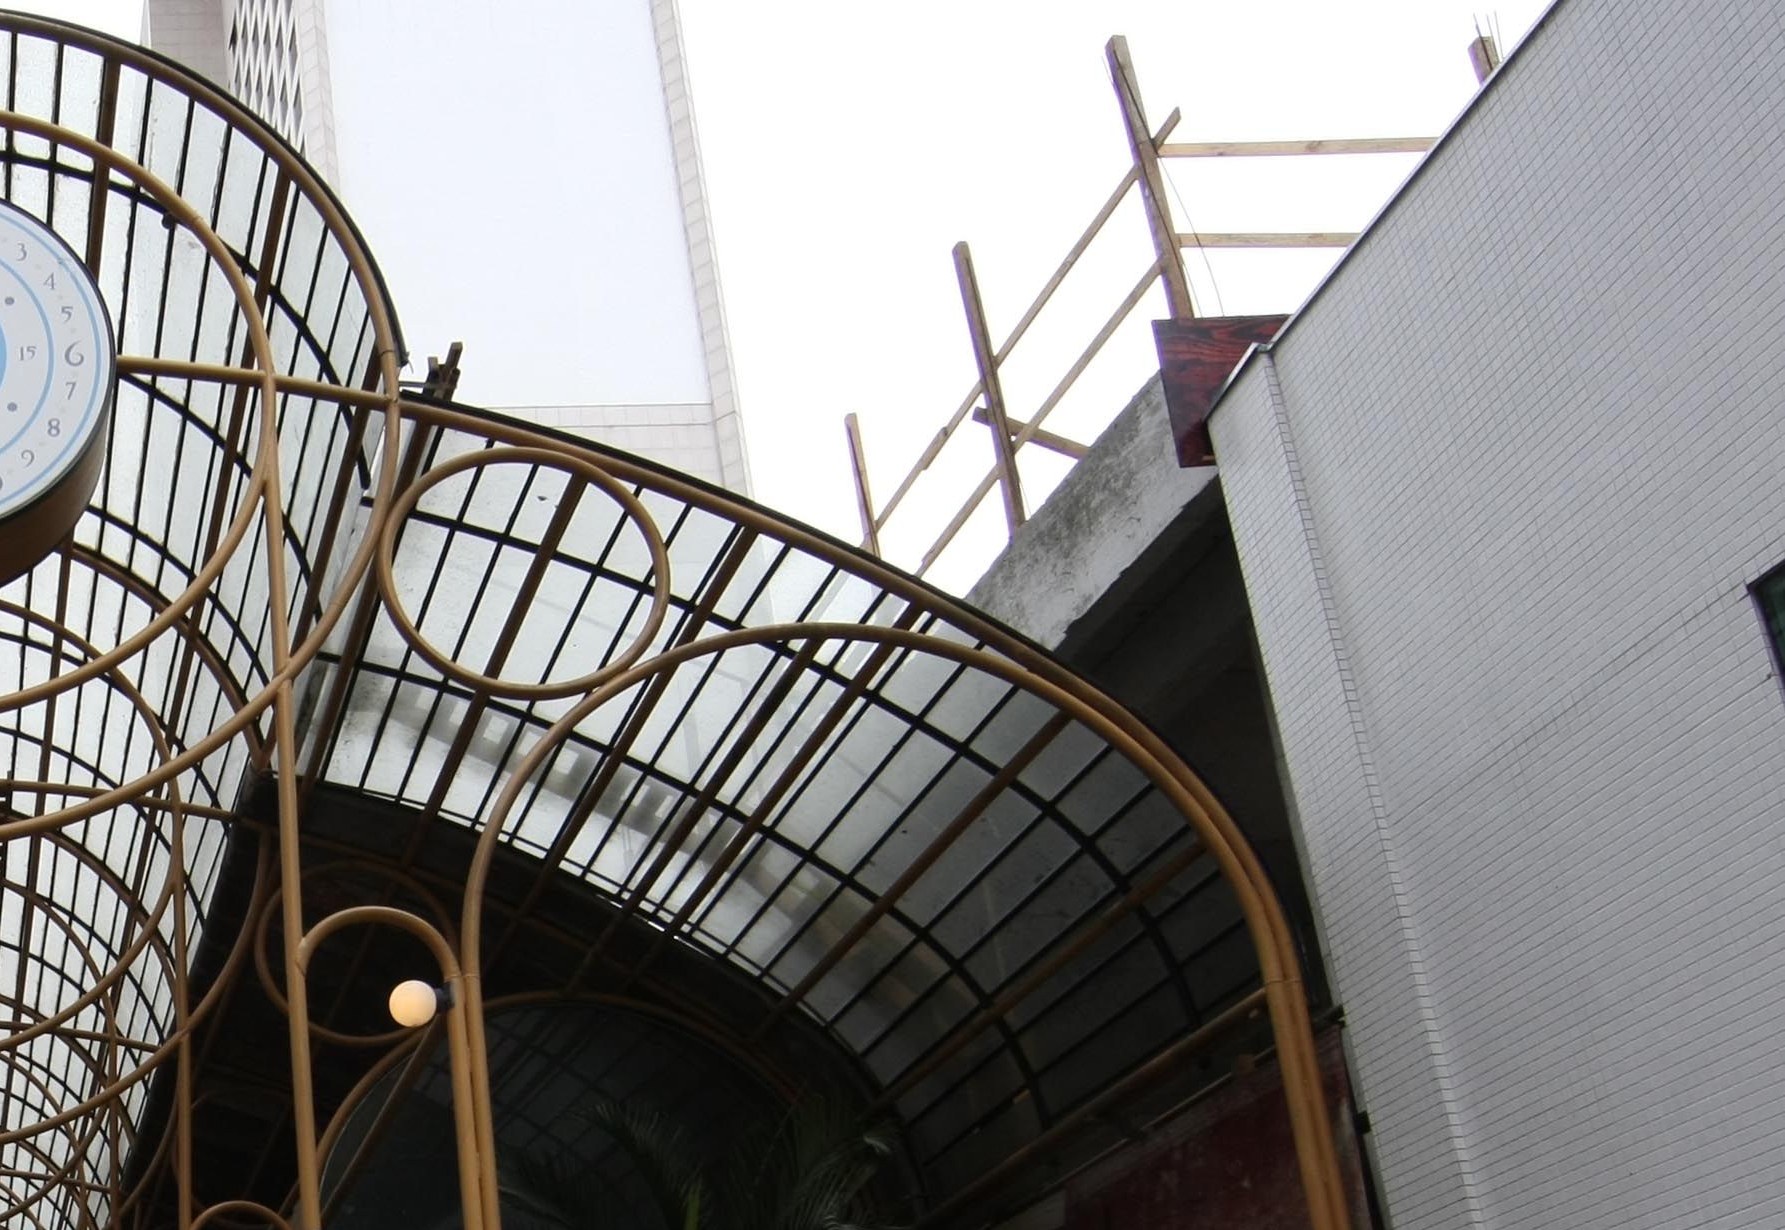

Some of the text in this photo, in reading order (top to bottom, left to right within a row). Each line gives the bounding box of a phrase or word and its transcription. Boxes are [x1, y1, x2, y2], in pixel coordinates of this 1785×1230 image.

[16, 243, 27, 262] 3
[43, 272, 56, 290] 4
[61, 306, 73, 323] 5
[19, 346, 37, 361] 15
[64, 340, 84, 367] 6
[65, 381, 77, 400] 7
[47, 418, 61, 437] 8
[21, 449, 35, 468] 9
